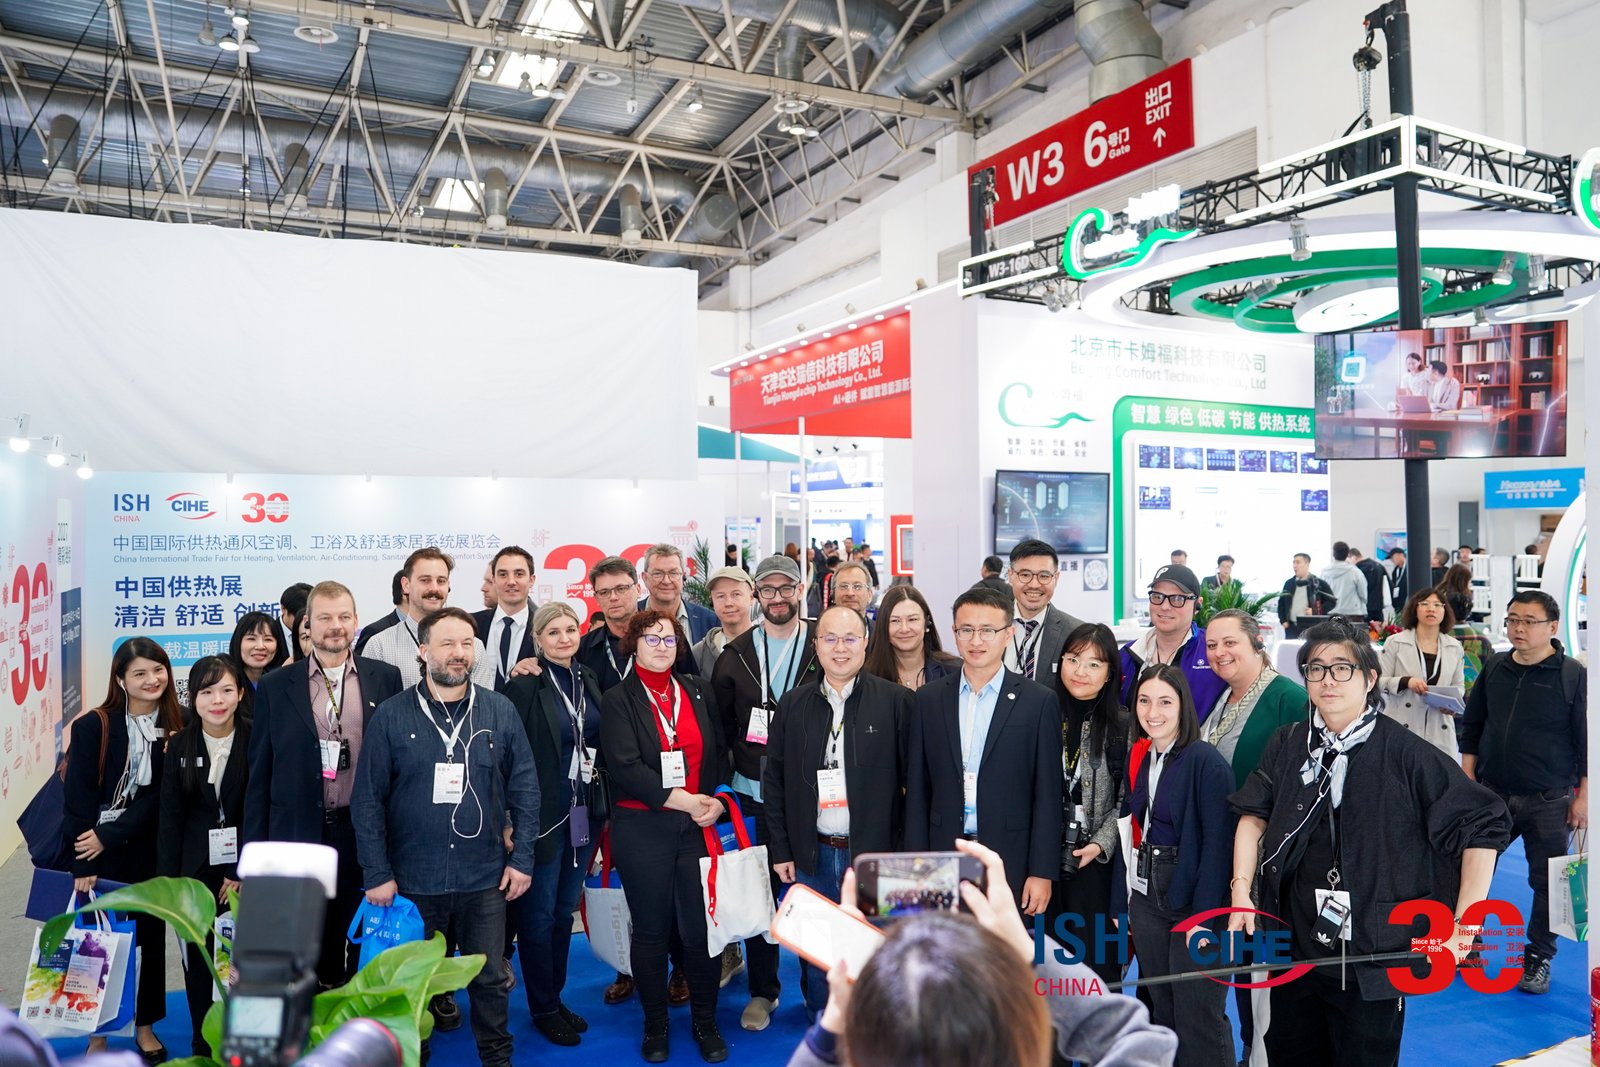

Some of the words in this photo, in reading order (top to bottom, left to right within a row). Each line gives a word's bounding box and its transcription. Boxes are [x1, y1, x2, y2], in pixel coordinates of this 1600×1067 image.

[1145, 80, 1172, 109] 出口
[1145, 101, 1172, 125] EXIT
[1006, 141, 1065, 201] W3
[1083, 120, 1108, 168] 6
[1108, 126, 1130, 148] 号门
[1108, 144, 1131, 160] Gate
[987, 255, 1030, 280] W3-16D
[1070, 334, 1267, 374] 北京市卡姆福科技有限公司
[1115, 364, 1162, 382] Comfort
[1251, 378, 1266, 390] Ltd
[1130, 403, 1161, 425] 智慧
[1165, 405, 1194, 427] 绿色
[1197, 407, 1226, 429] 低碳
[1229, 409, 1256, 431] 节能
[1258, 411, 1311, 434] 供热系统
[113, 494, 150, 512] ISH
[171, 500, 209, 512] CIHE
[241, 492, 289, 523] 30
[113, 515, 140, 523] CHINA
[113, 533, 501, 551] 中国国际供热通风空调、卫浴及舒适家居系统展览会
[113, 554, 138, 564] China
[139, 554, 190, 563] International
[192, 554, 214, 563] Trade
[215, 554, 229, 563] Fair
[231, 554, 242, 562] for
[243, 553, 275, 564] Heating,
[115, 575, 243, 599] 中国供热展
[582, 590, 595, 598] 199
[114, 604, 166, 628] 清洁
[175, 603, 225, 626] 舒适
[11, 561, 49, 706] 30
